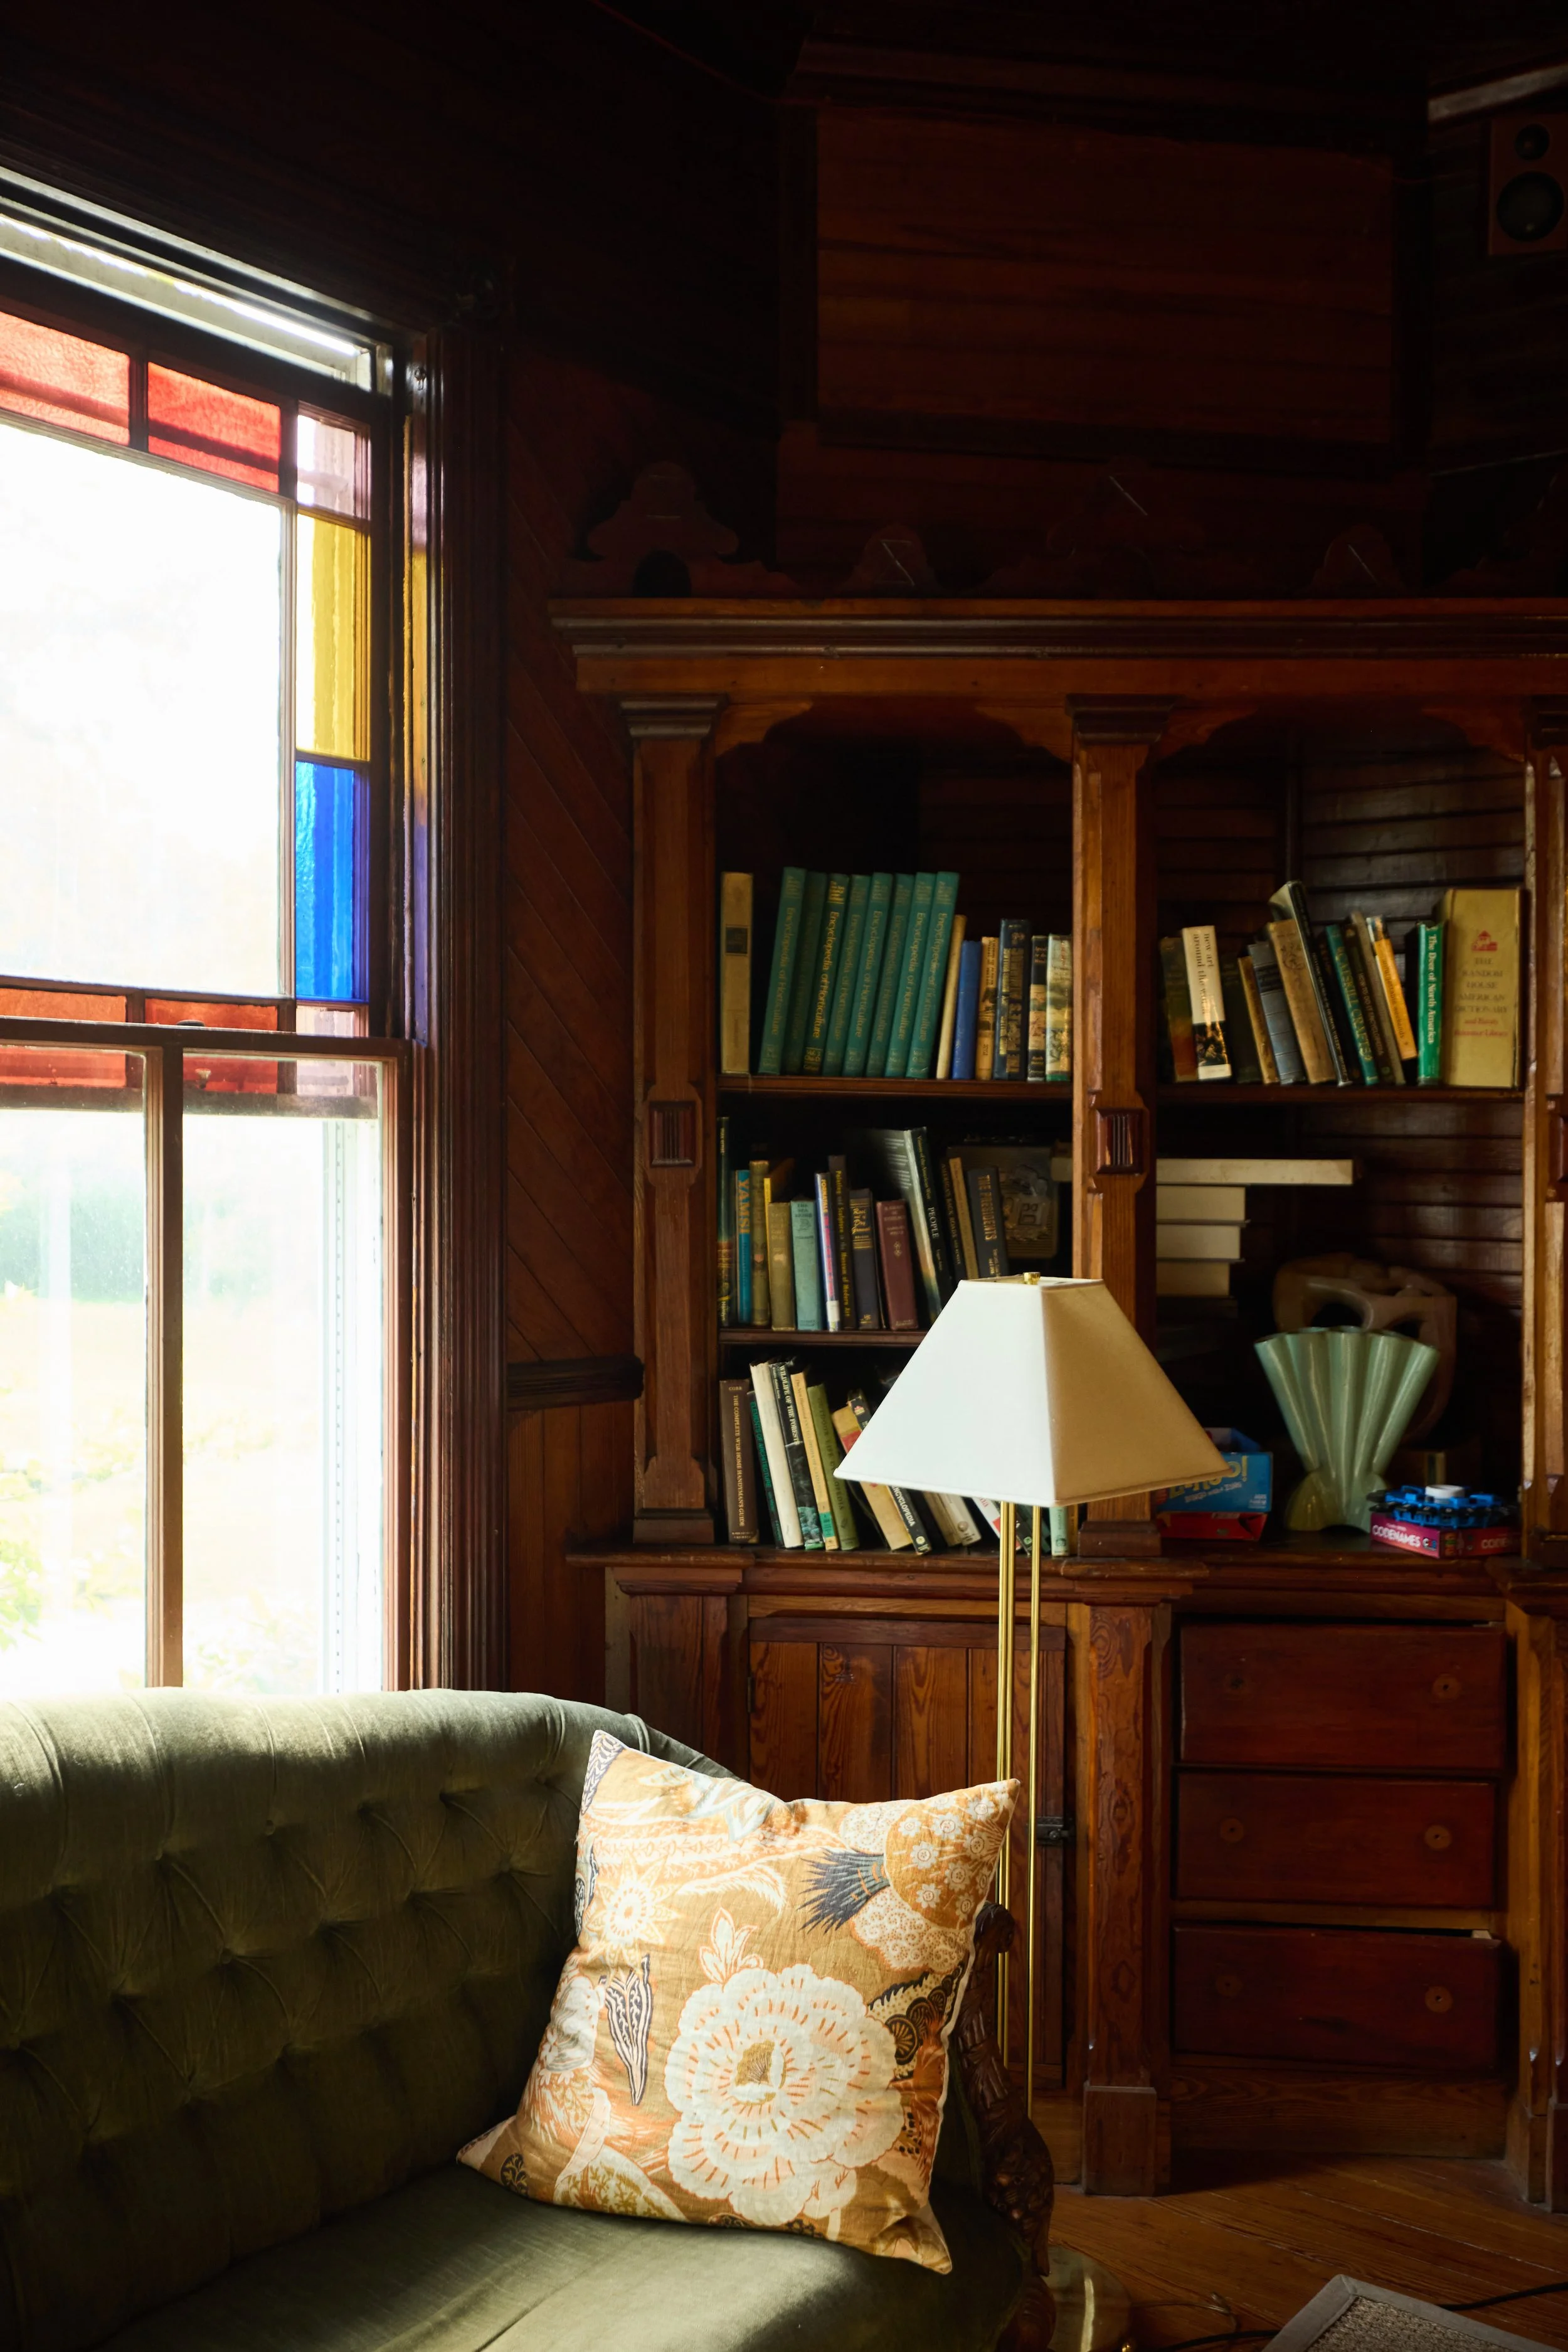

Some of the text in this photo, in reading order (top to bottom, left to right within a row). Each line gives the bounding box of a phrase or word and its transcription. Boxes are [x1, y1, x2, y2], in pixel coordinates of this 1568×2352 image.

[778, 906, 796, 967] Encyclopedia
[821, 910, 839, 970] Encyclopedia
[863, 910, 882, 970] Encyclopedia
[906, 912, 926, 972] Encyclopedia
[928, 912, 947, 972] Encyclopedia
[1193, 933, 1204, 967] around
[778, 968, 788, 979] of
[820, 972, 830, 984] of
[862, 972, 872, 982] of
[906, 974, 916, 984] of
[928, 974, 938, 985] of
[1197, 970, 1207, 985] the
[1428, 934, 1437, 1044] The Deer of North America
[771, 981, 787, 1035] Horticulture
[812, 984, 829, 1038] Horticulture
[854, 983, 871, 1038] Horticulture
[897, 985, 914, 1040] Horticulture
[919, 986, 936, 1041] Horticulture
[1337, 952, 1371, 1055] CATSKILL CRAFTS
[834, 1170, 843, 1194] Painting
[921, 1166, 931, 1188] American
[924, 1187, 933, 1200] West
[978, 1174, 992, 1189] THE
[737, 1178, 751, 1233] YAMSI
[836, 1206, 845, 1232] Sculpture
[927, 1206, 940, 1238] PEOPLE
[980, 1191, 997, 1240] PRESIDENTS
[779, 1365, 790, 1395] WILDLIFE
[785, 1395, 792, 1404] OF
[786, 1404, 795, 1418] THE
[750, 1401, 761, 1432] ELEMENTS
[758, 1442, 771, 1487] ARCHITECTURE
[816, 1398, 829, 1435] OUTDOOR
[824, 1439, 833, 1457] LIFE
[1372, 1525, 1421, 1548] CODENAMES
